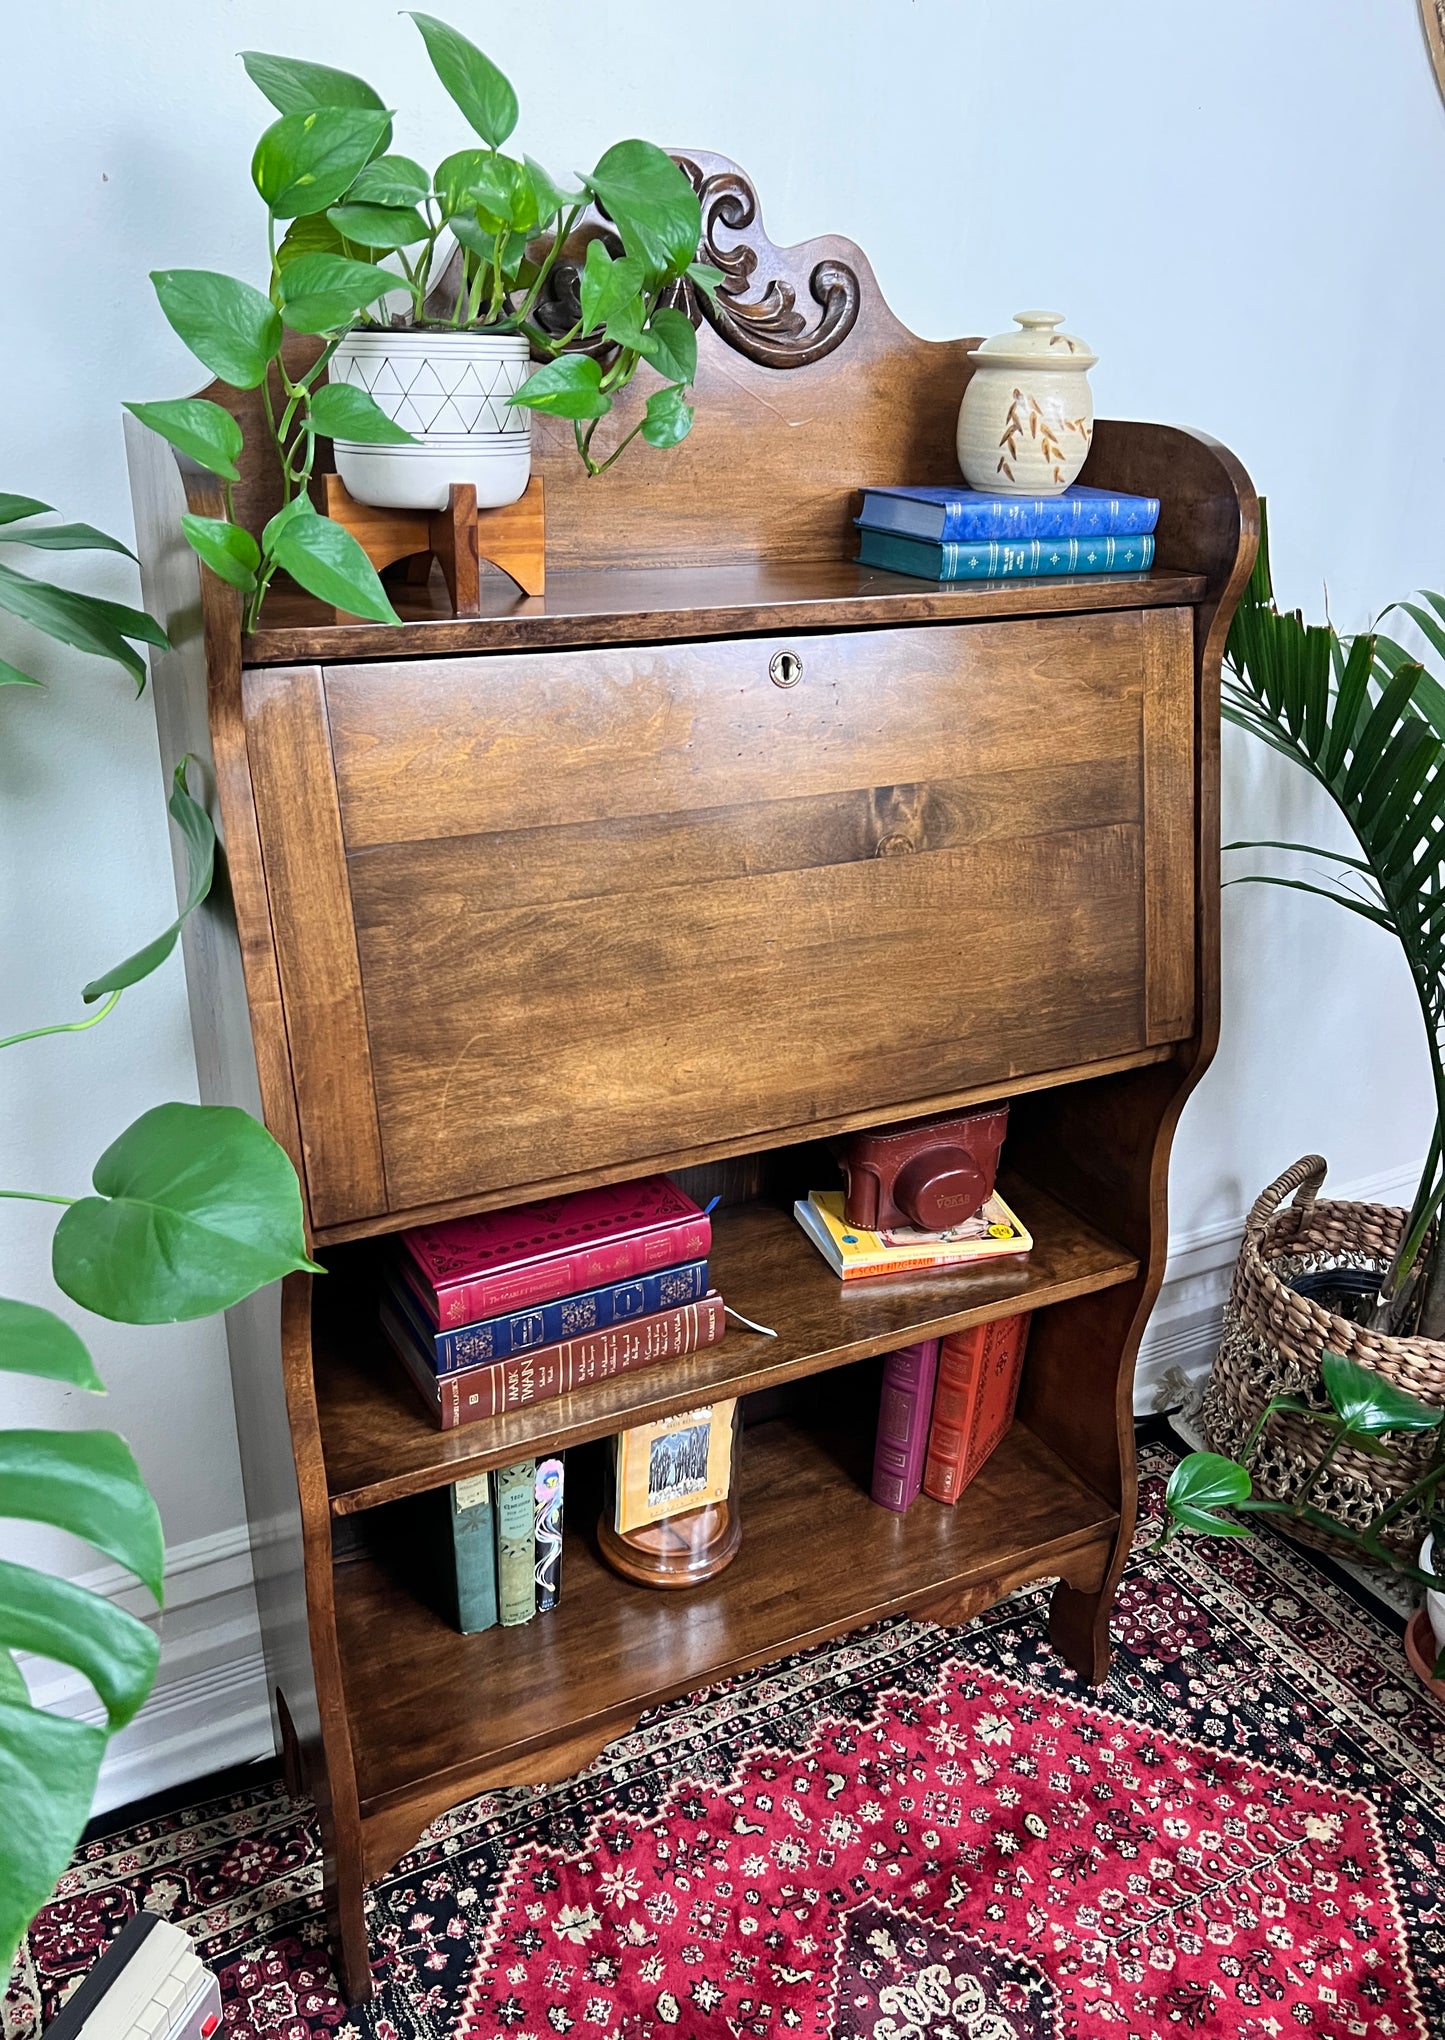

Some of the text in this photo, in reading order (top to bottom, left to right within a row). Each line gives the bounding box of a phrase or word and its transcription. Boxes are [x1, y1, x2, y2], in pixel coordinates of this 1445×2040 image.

[859, 1265, 884, 1275] SCOTT
[886, 1258, 934, 1271] FITZGERALD
[509, 1369, 519, 1401] MARK
[521, 1359, 534, 1402] TWAIN
